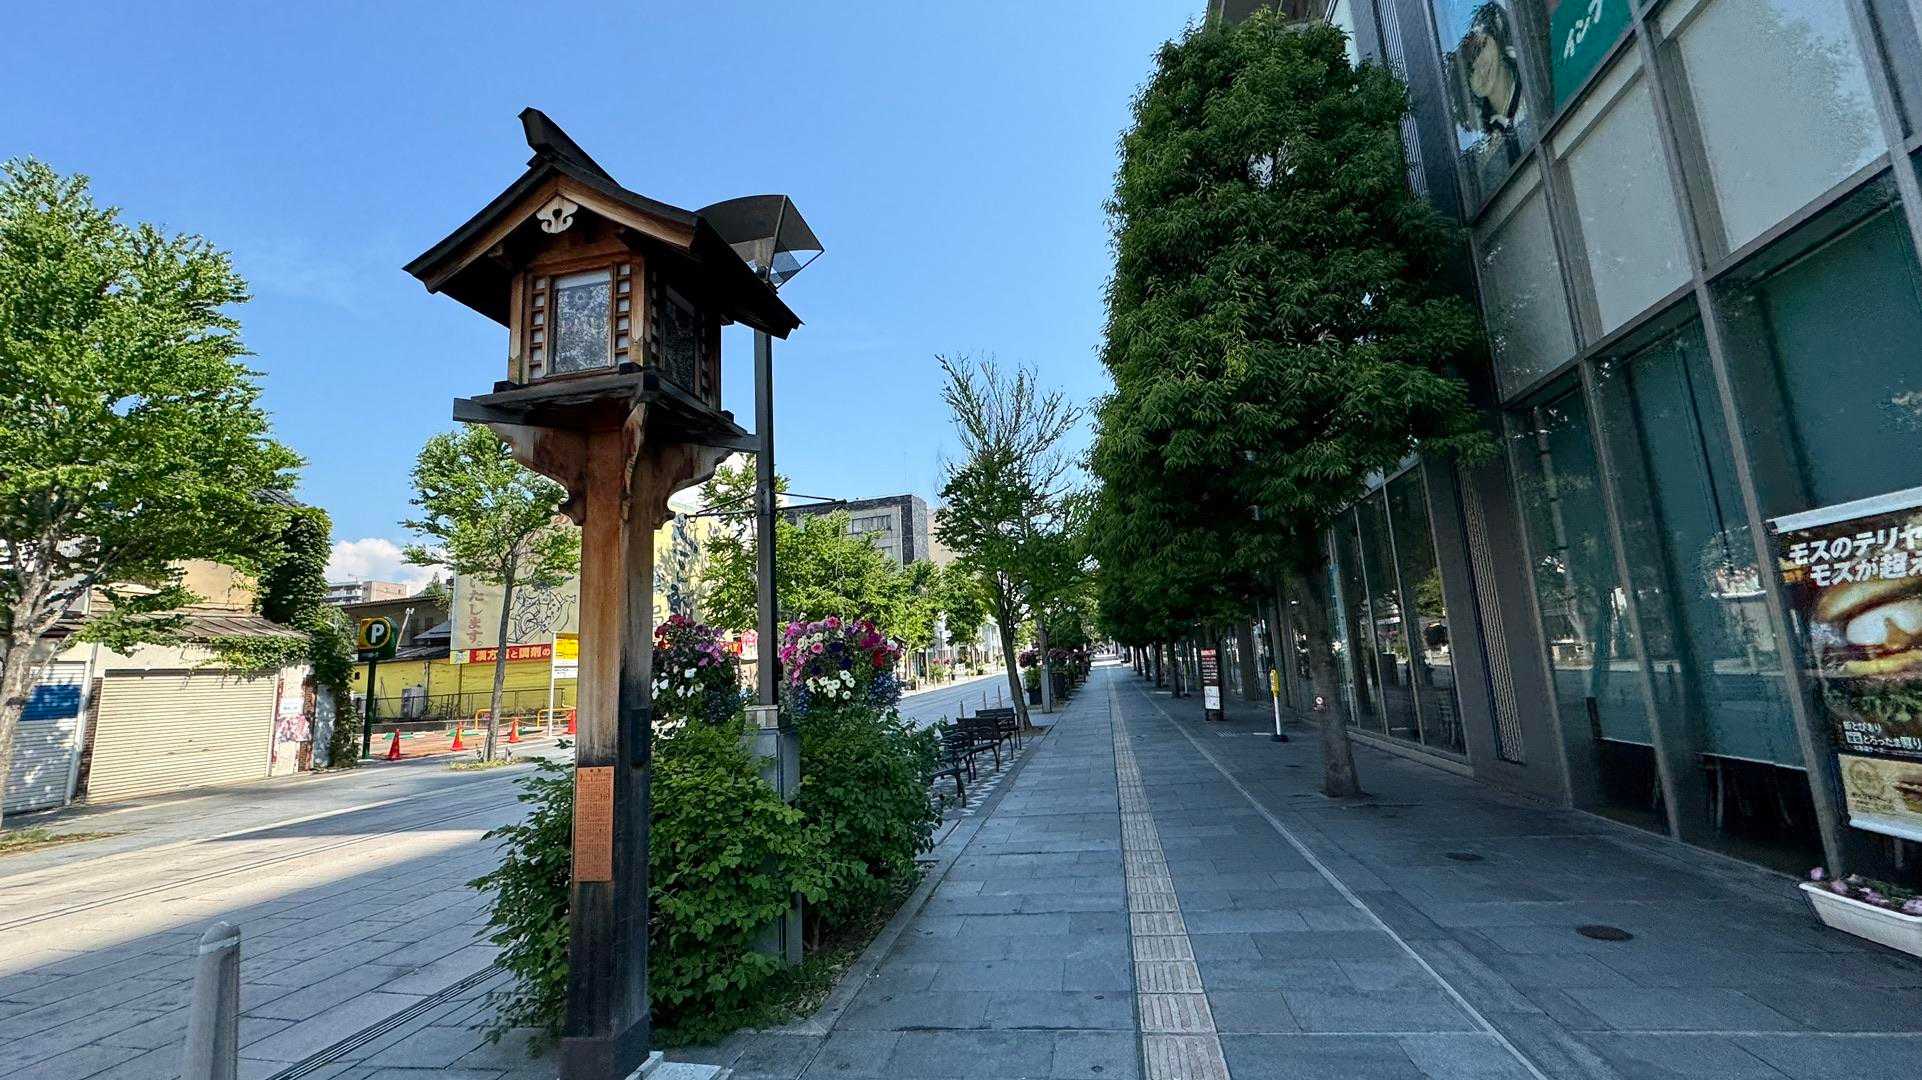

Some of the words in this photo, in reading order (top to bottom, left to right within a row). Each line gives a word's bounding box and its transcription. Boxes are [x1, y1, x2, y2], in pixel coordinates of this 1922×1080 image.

[371, 623, 385, 644] P
[475, 646, 551, 662] 漢方と調剤の
